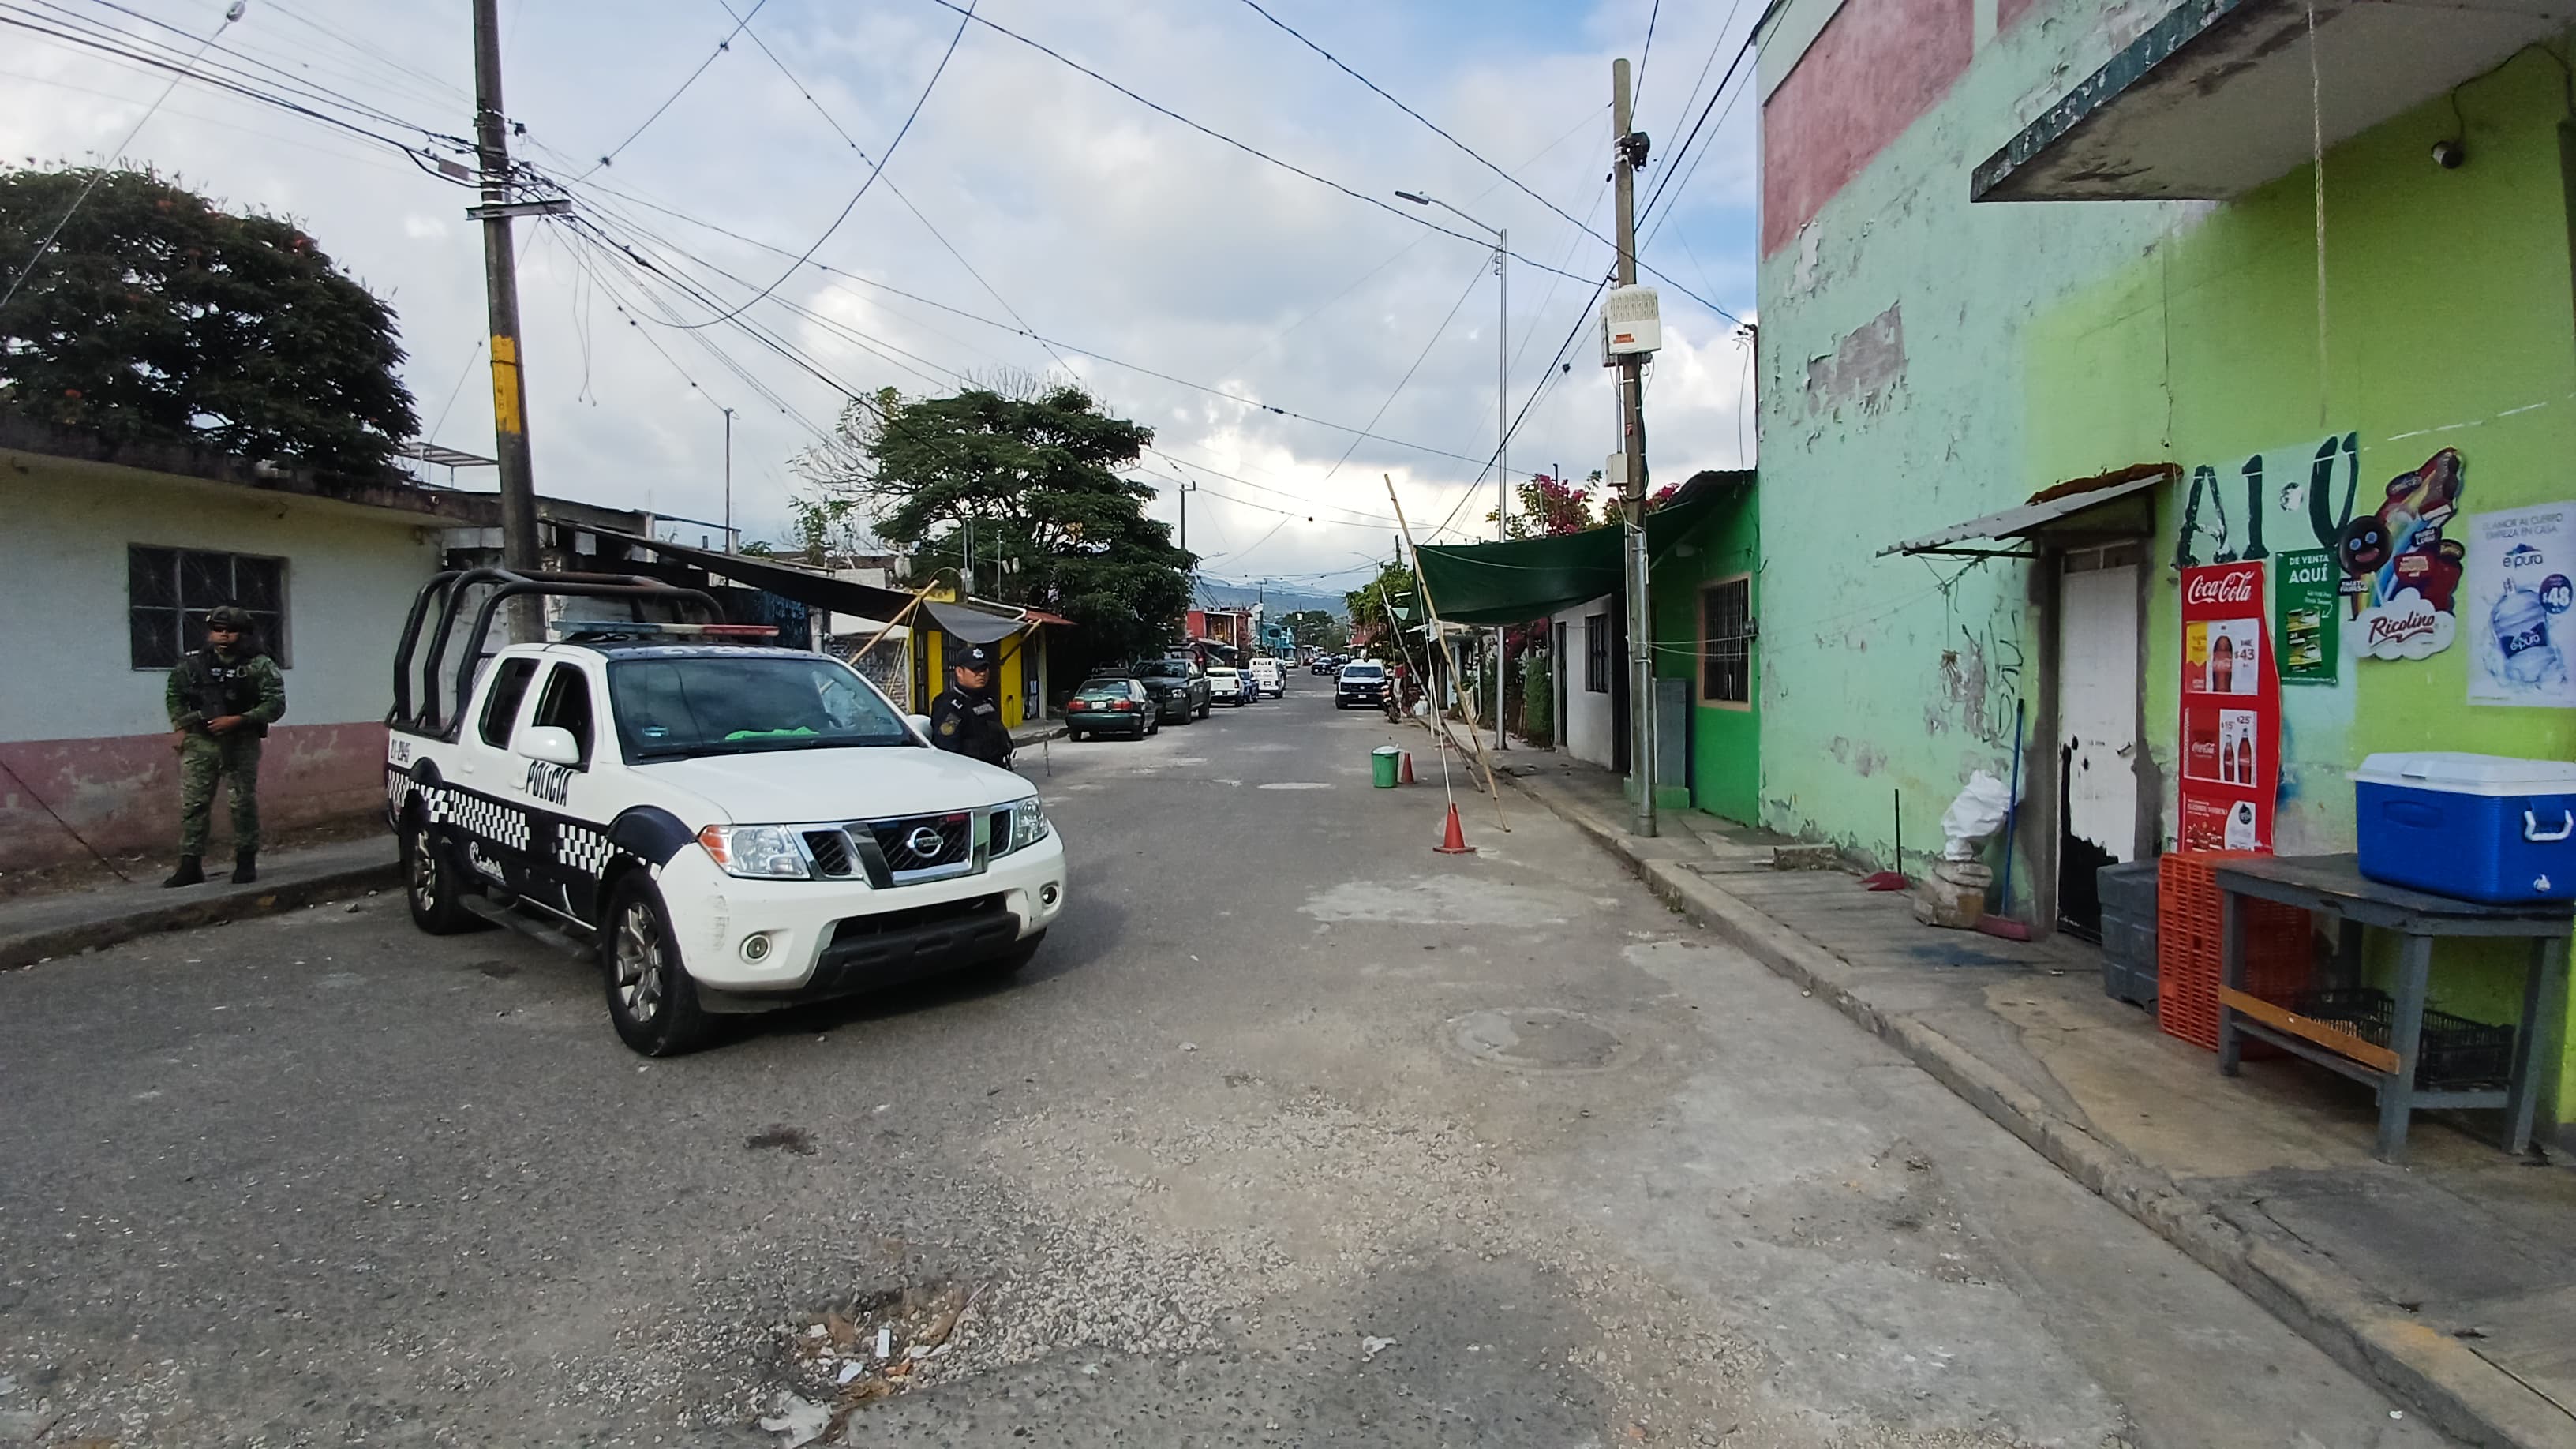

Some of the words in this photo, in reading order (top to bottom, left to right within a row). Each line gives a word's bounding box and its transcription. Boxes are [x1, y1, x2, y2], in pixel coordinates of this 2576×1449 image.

[2302, 554, 2329, 564] VENTA
[2288, 564, 2329, 583] AQUÍ
[2188, 571, 2255, 605] Coca-Cola
[2543, 586, 2570, 607] $48
[2368, 610, 2435, 644] Ricolino
[2234, 648, 2255, 661] $43
